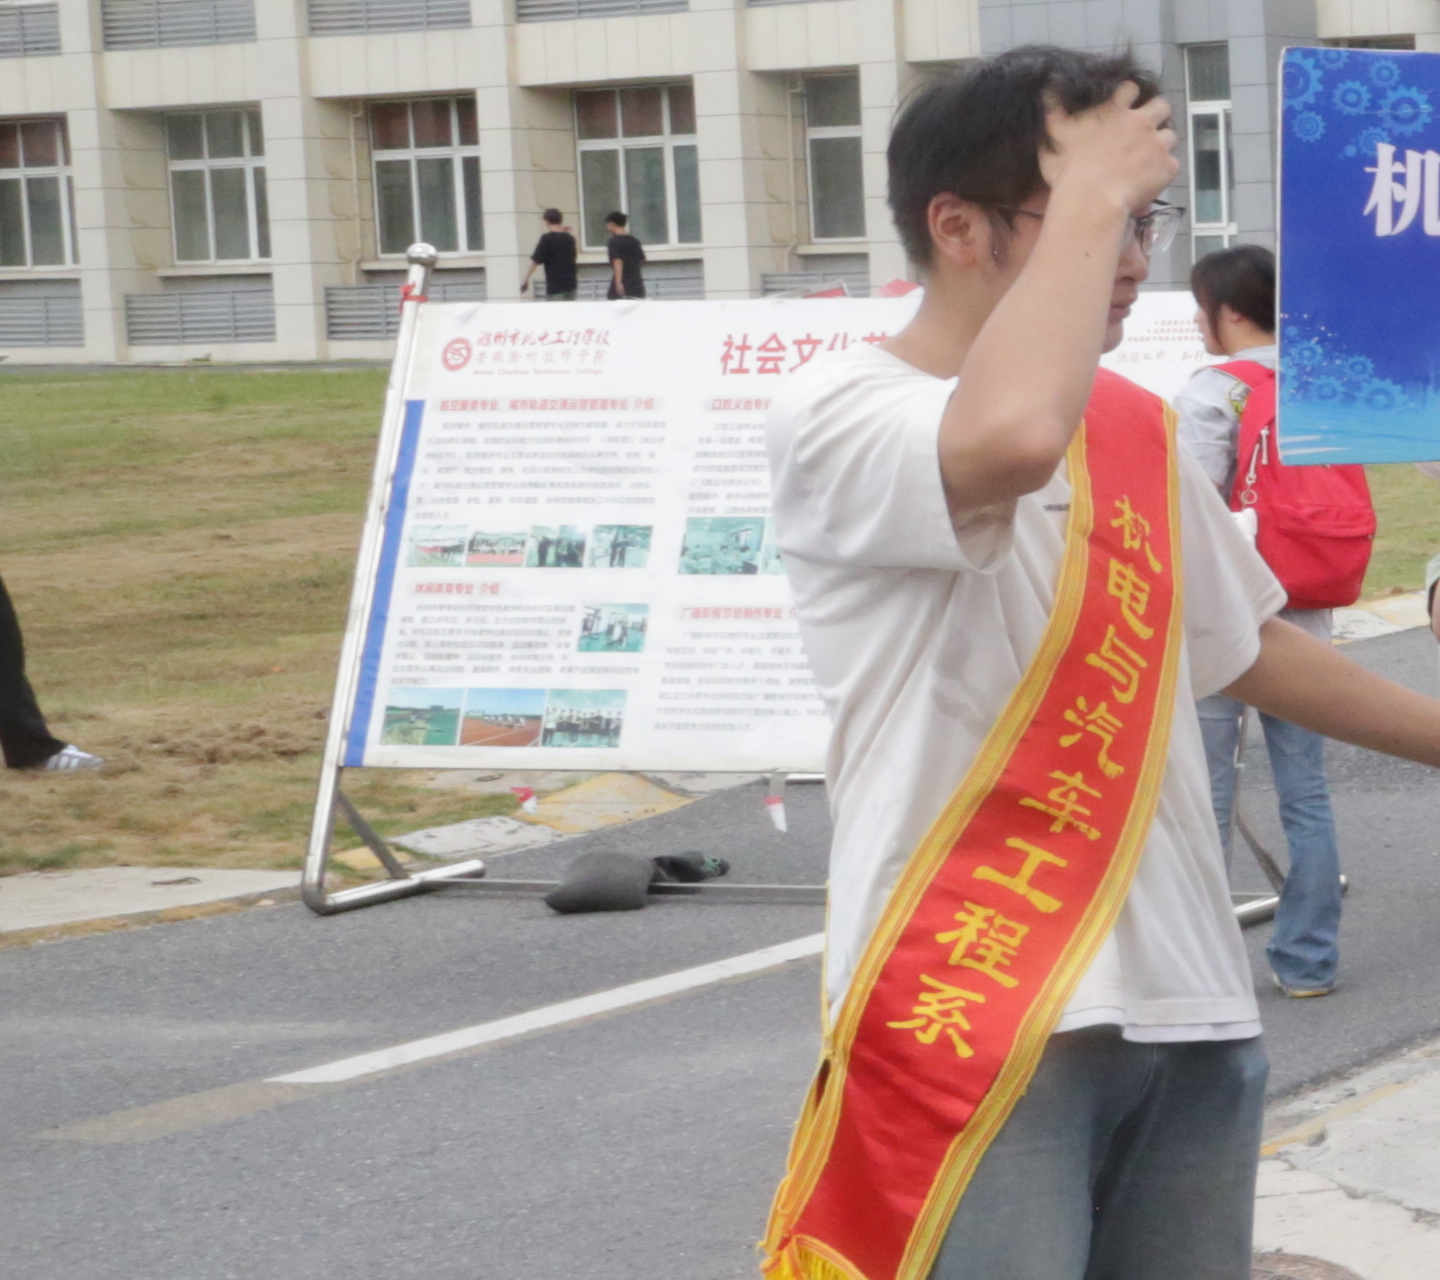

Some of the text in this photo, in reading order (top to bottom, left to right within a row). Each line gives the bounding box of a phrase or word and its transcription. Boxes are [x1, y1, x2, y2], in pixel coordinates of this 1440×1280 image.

[886, 494, 1164, 1063] 机电与汽车工程系
